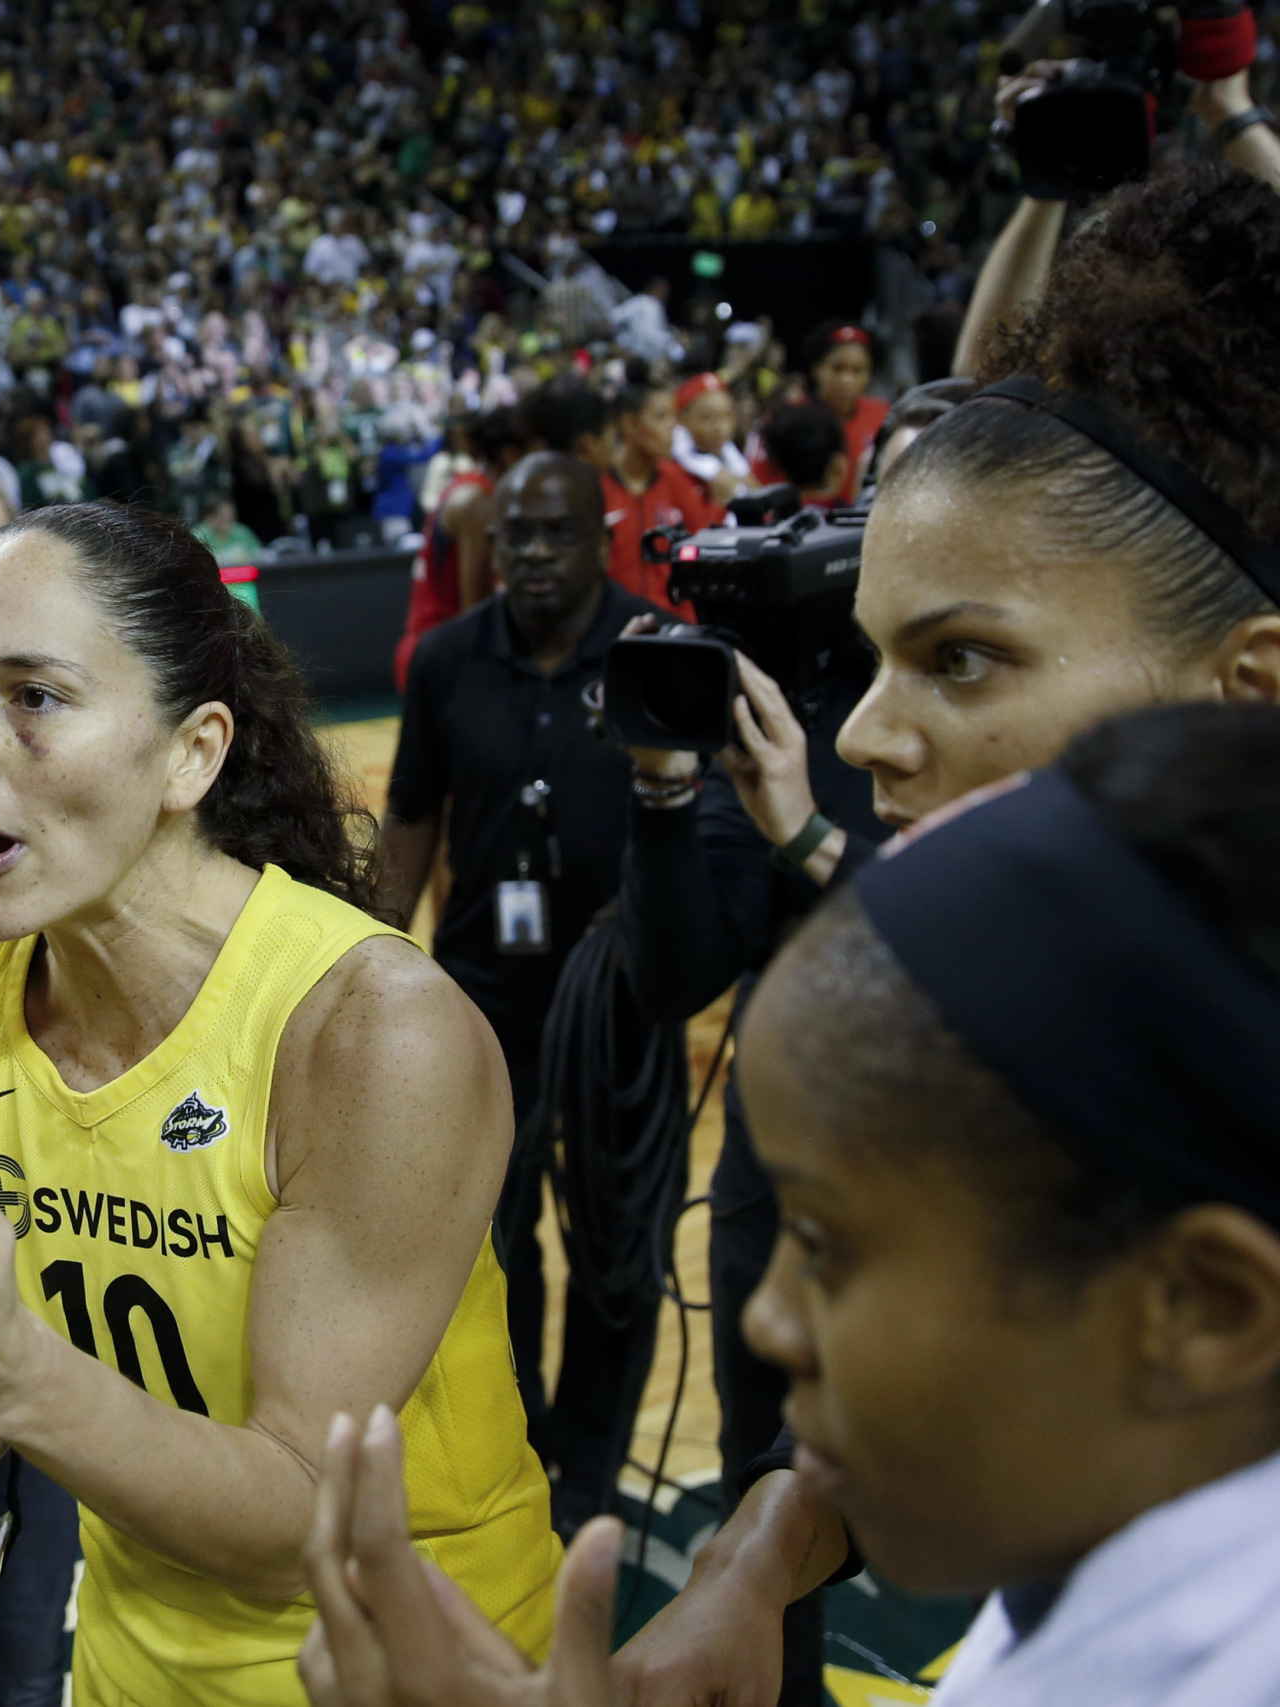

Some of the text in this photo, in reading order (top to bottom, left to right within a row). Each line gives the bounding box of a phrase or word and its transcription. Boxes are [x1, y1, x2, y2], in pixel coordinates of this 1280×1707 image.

[162, 1111, 222, 1137] STORM
[32, 1186, 236, 1260] SWEDISH
[39, 1259, 211, 1419] 10
